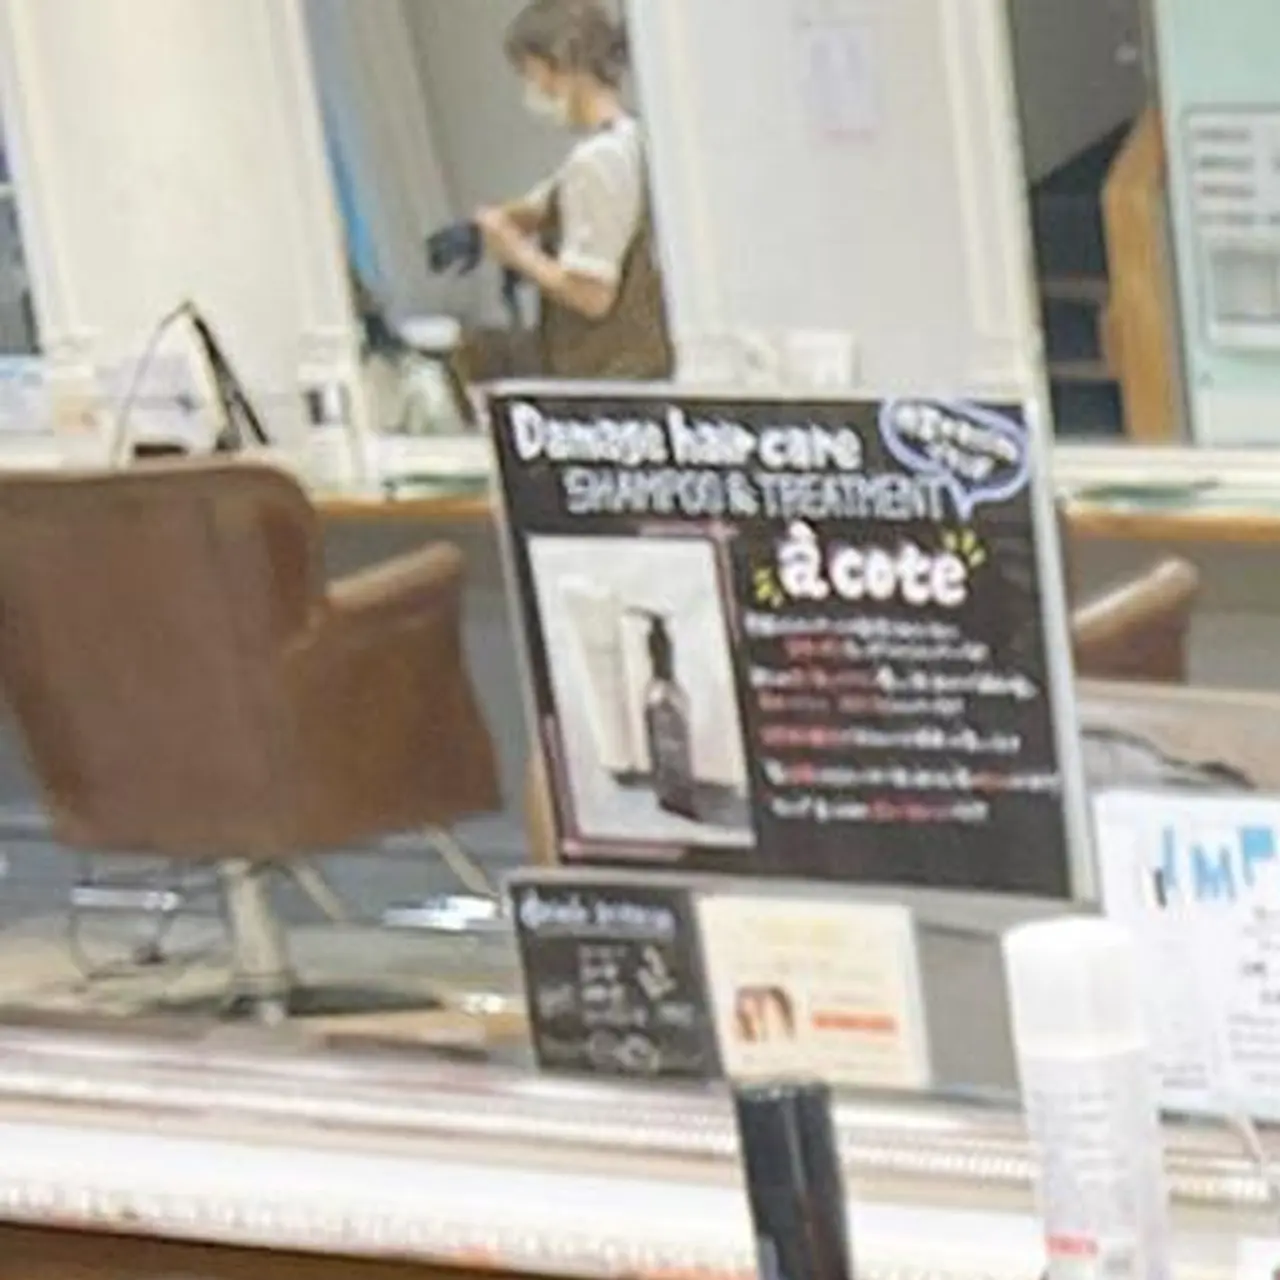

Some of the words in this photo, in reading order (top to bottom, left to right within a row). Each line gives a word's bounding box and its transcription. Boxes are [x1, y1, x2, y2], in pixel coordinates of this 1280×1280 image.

[509, 400, 667, 466] Damage
[665, 403, 757, 467] hair
[758, 424, 863, 470] care
[562, 466, 725, 516] SHAMPOO
